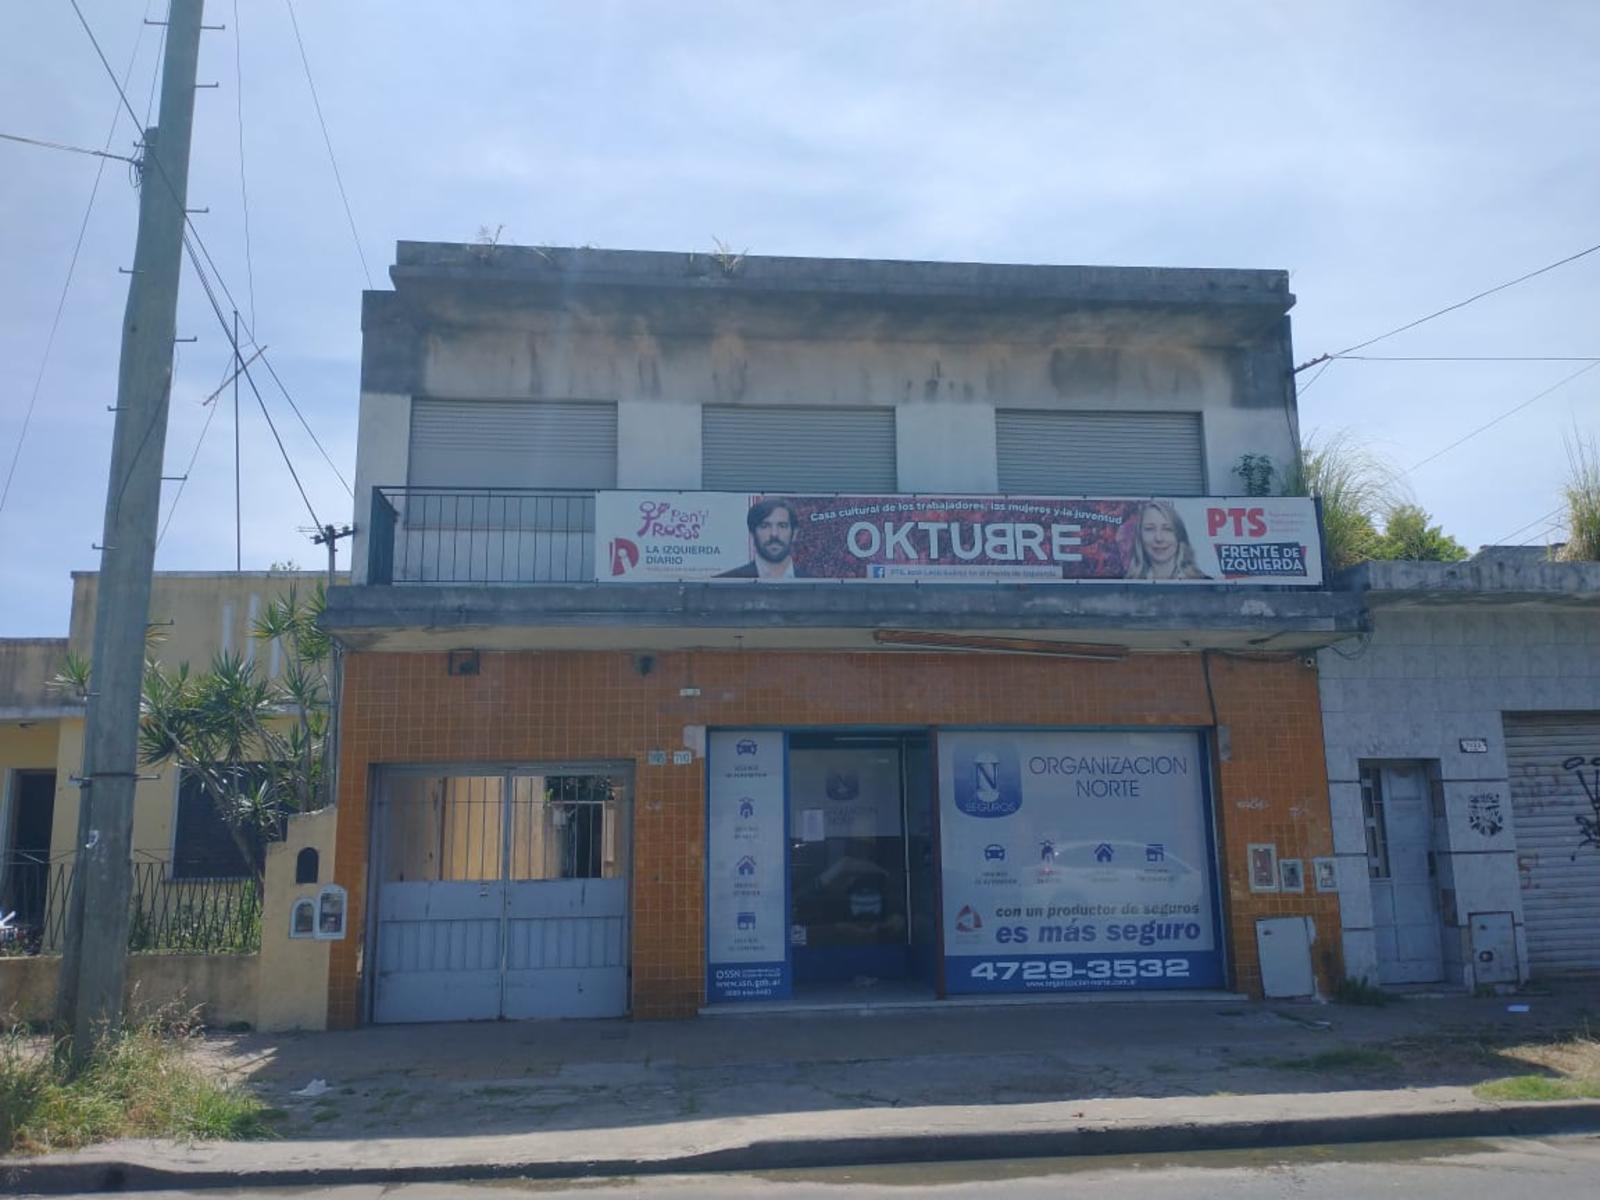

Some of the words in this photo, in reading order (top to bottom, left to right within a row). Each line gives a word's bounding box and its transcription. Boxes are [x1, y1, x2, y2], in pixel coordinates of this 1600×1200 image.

[811, 511, 837, 521] Casa
[838, 504, 880, 517] cultural
[882, 504, 896, 512] de
[898, 502, 915, 511] los
[991, 502, 1006, 511] las
[1074, 508, 1122, 524] juventud
[1206, 507, 1268, 537] PTS
[645, 545, 660, 554] LA
[662, 545, 721, 555] IZQUIERDA
[847, 520, 1083, 562] OKTUBRE
[645, 555, 684, 565] DIARIO
[1221, 545, 1280, 558] FRENTE
[1283, 547, 1301, 558] DE
[1220, 558, 1303, 571] IZQUIERDA
[1028, 755, 1188, 775] ORGANIZACION
[974, 761, 1001, 791] N
[1076, 779, 1140, 798] NORTE
[965, 800, 1017, 813] SEGUROS
[995, 906, 1022, 918] con
[1026, 906, 1043, 917] un
[1047, 902, 1118, 920] productor
[1121, 902, 1140, 915] de
[1143, 903, 1200, 919] seguros
[995, 925, 1029, 944] es
[1038, 918, 1097, 943] más
[1106, 920, 1201, 947] seguro
[970, 958, 1190, 981] 4729-3532
